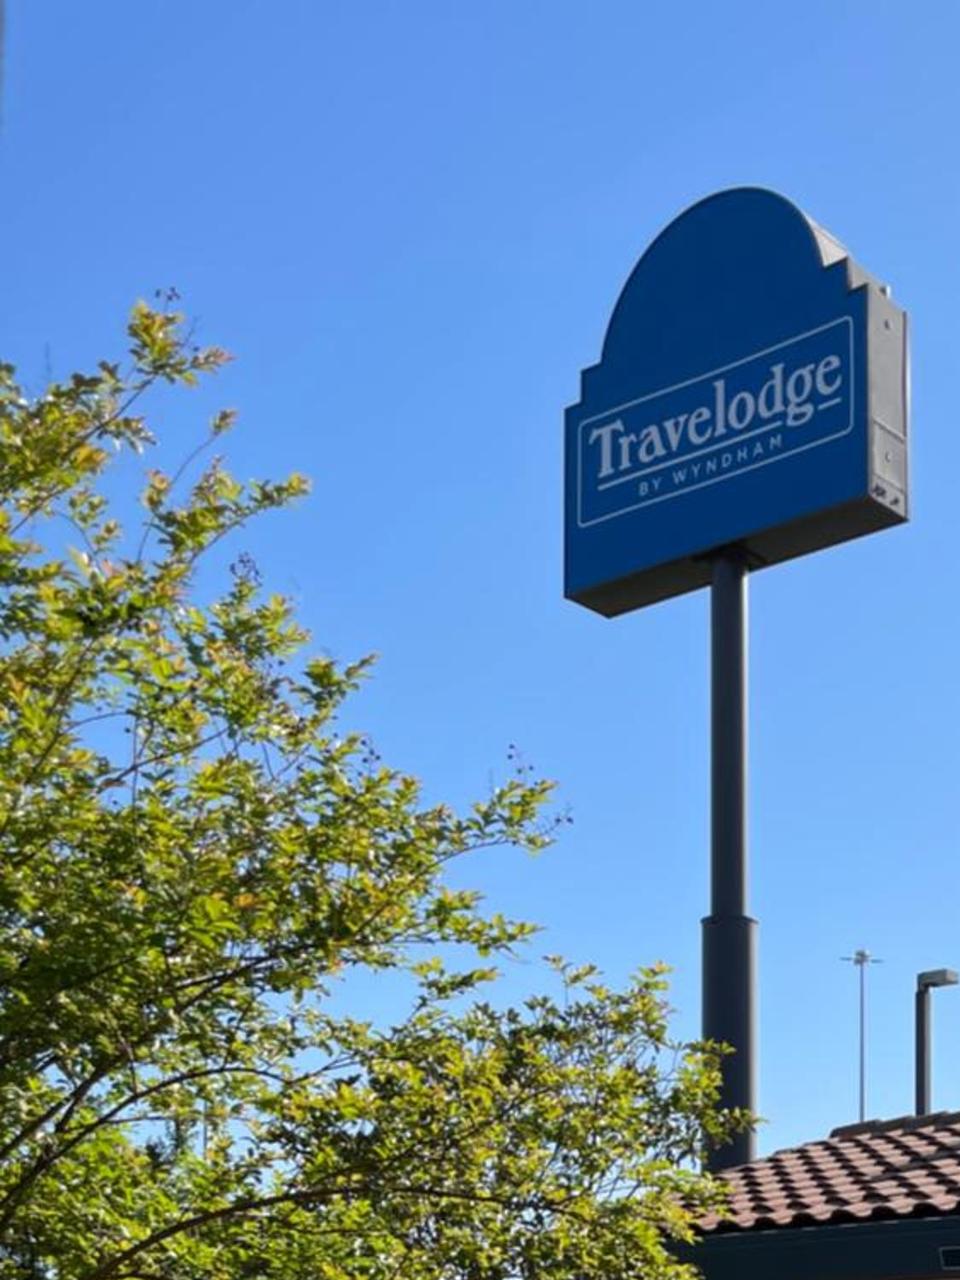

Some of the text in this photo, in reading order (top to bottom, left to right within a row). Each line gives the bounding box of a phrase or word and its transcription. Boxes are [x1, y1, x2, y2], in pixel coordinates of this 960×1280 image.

[589, 355, 843, 478] Travelodge
[638, 434, 784, 496] BY WYNDHAM
